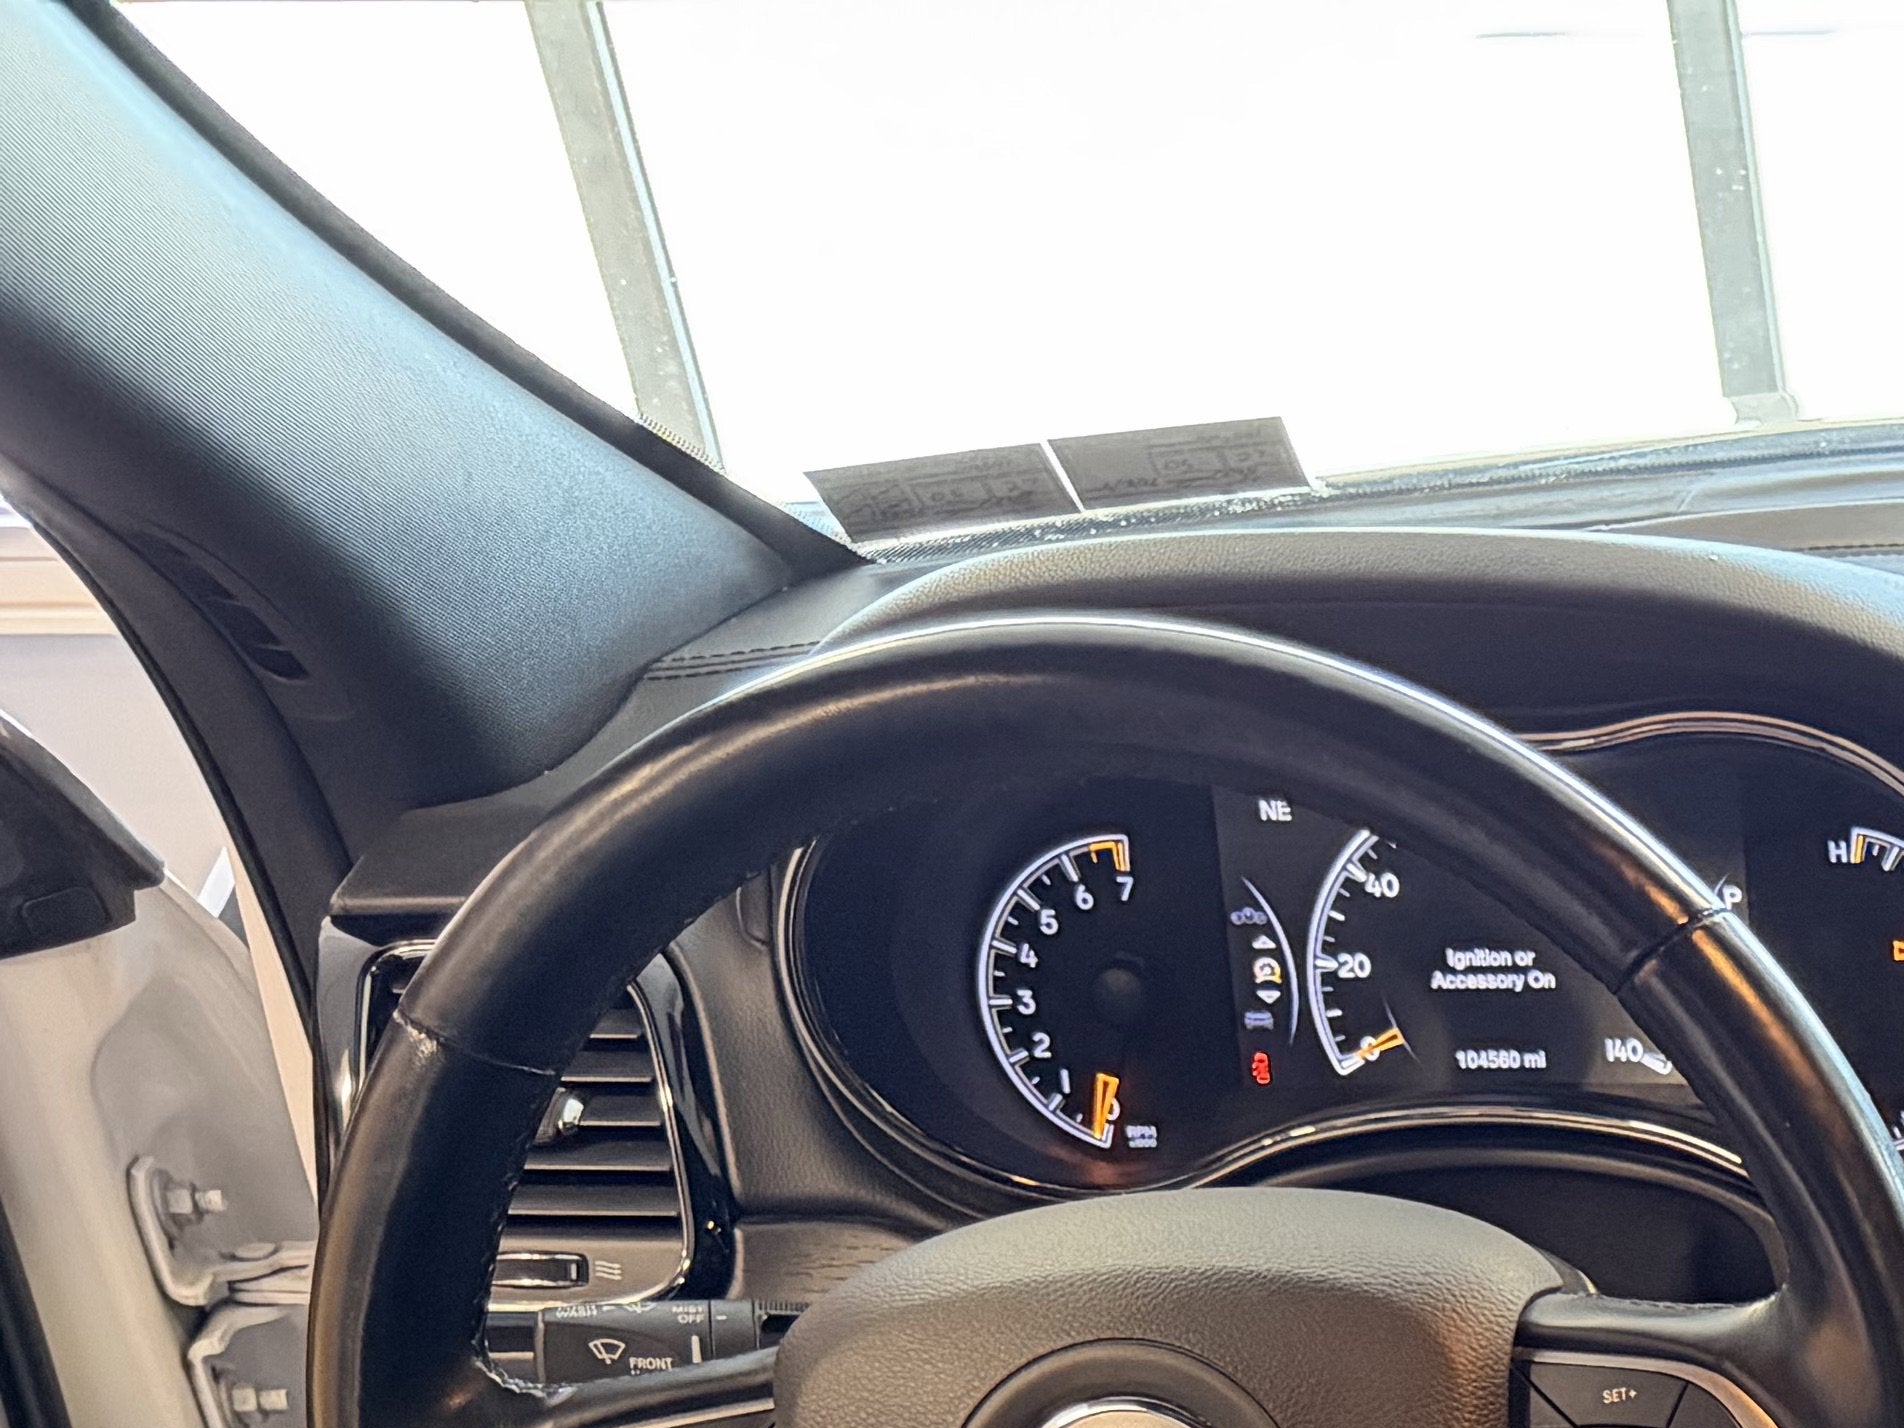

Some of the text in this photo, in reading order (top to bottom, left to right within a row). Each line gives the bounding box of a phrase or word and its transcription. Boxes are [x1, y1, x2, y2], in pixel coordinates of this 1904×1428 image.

[1258, 799, 1293, 822] NE
[1828, 840, 1848, 863] H
[1075, 884, 1094, 910] 6
[1115, 875, 1133, 901] 7
[1365, 872, 1400, 898] 40
[1039, 909, 1059, 935] 5
[1018, 942, 1039, 968] 4
[1337, 953, 1371, 978] 20
[1445, 947, 1535, 969] Ignition or
[1431, 970, 1556, 992] Accessory On
[1016, 989, 1036, 1015] 3
[1032, 1031, 1052, 1058] 2
[1604, 1038, 1643, 1063] 140
[1524, 1048, 1546, 1069] mi
[1060, 1068, 1070, 1094] 1
[677, 1314, 704, 1324] OFF
[629, 1357, 673, 1372] FRONT
